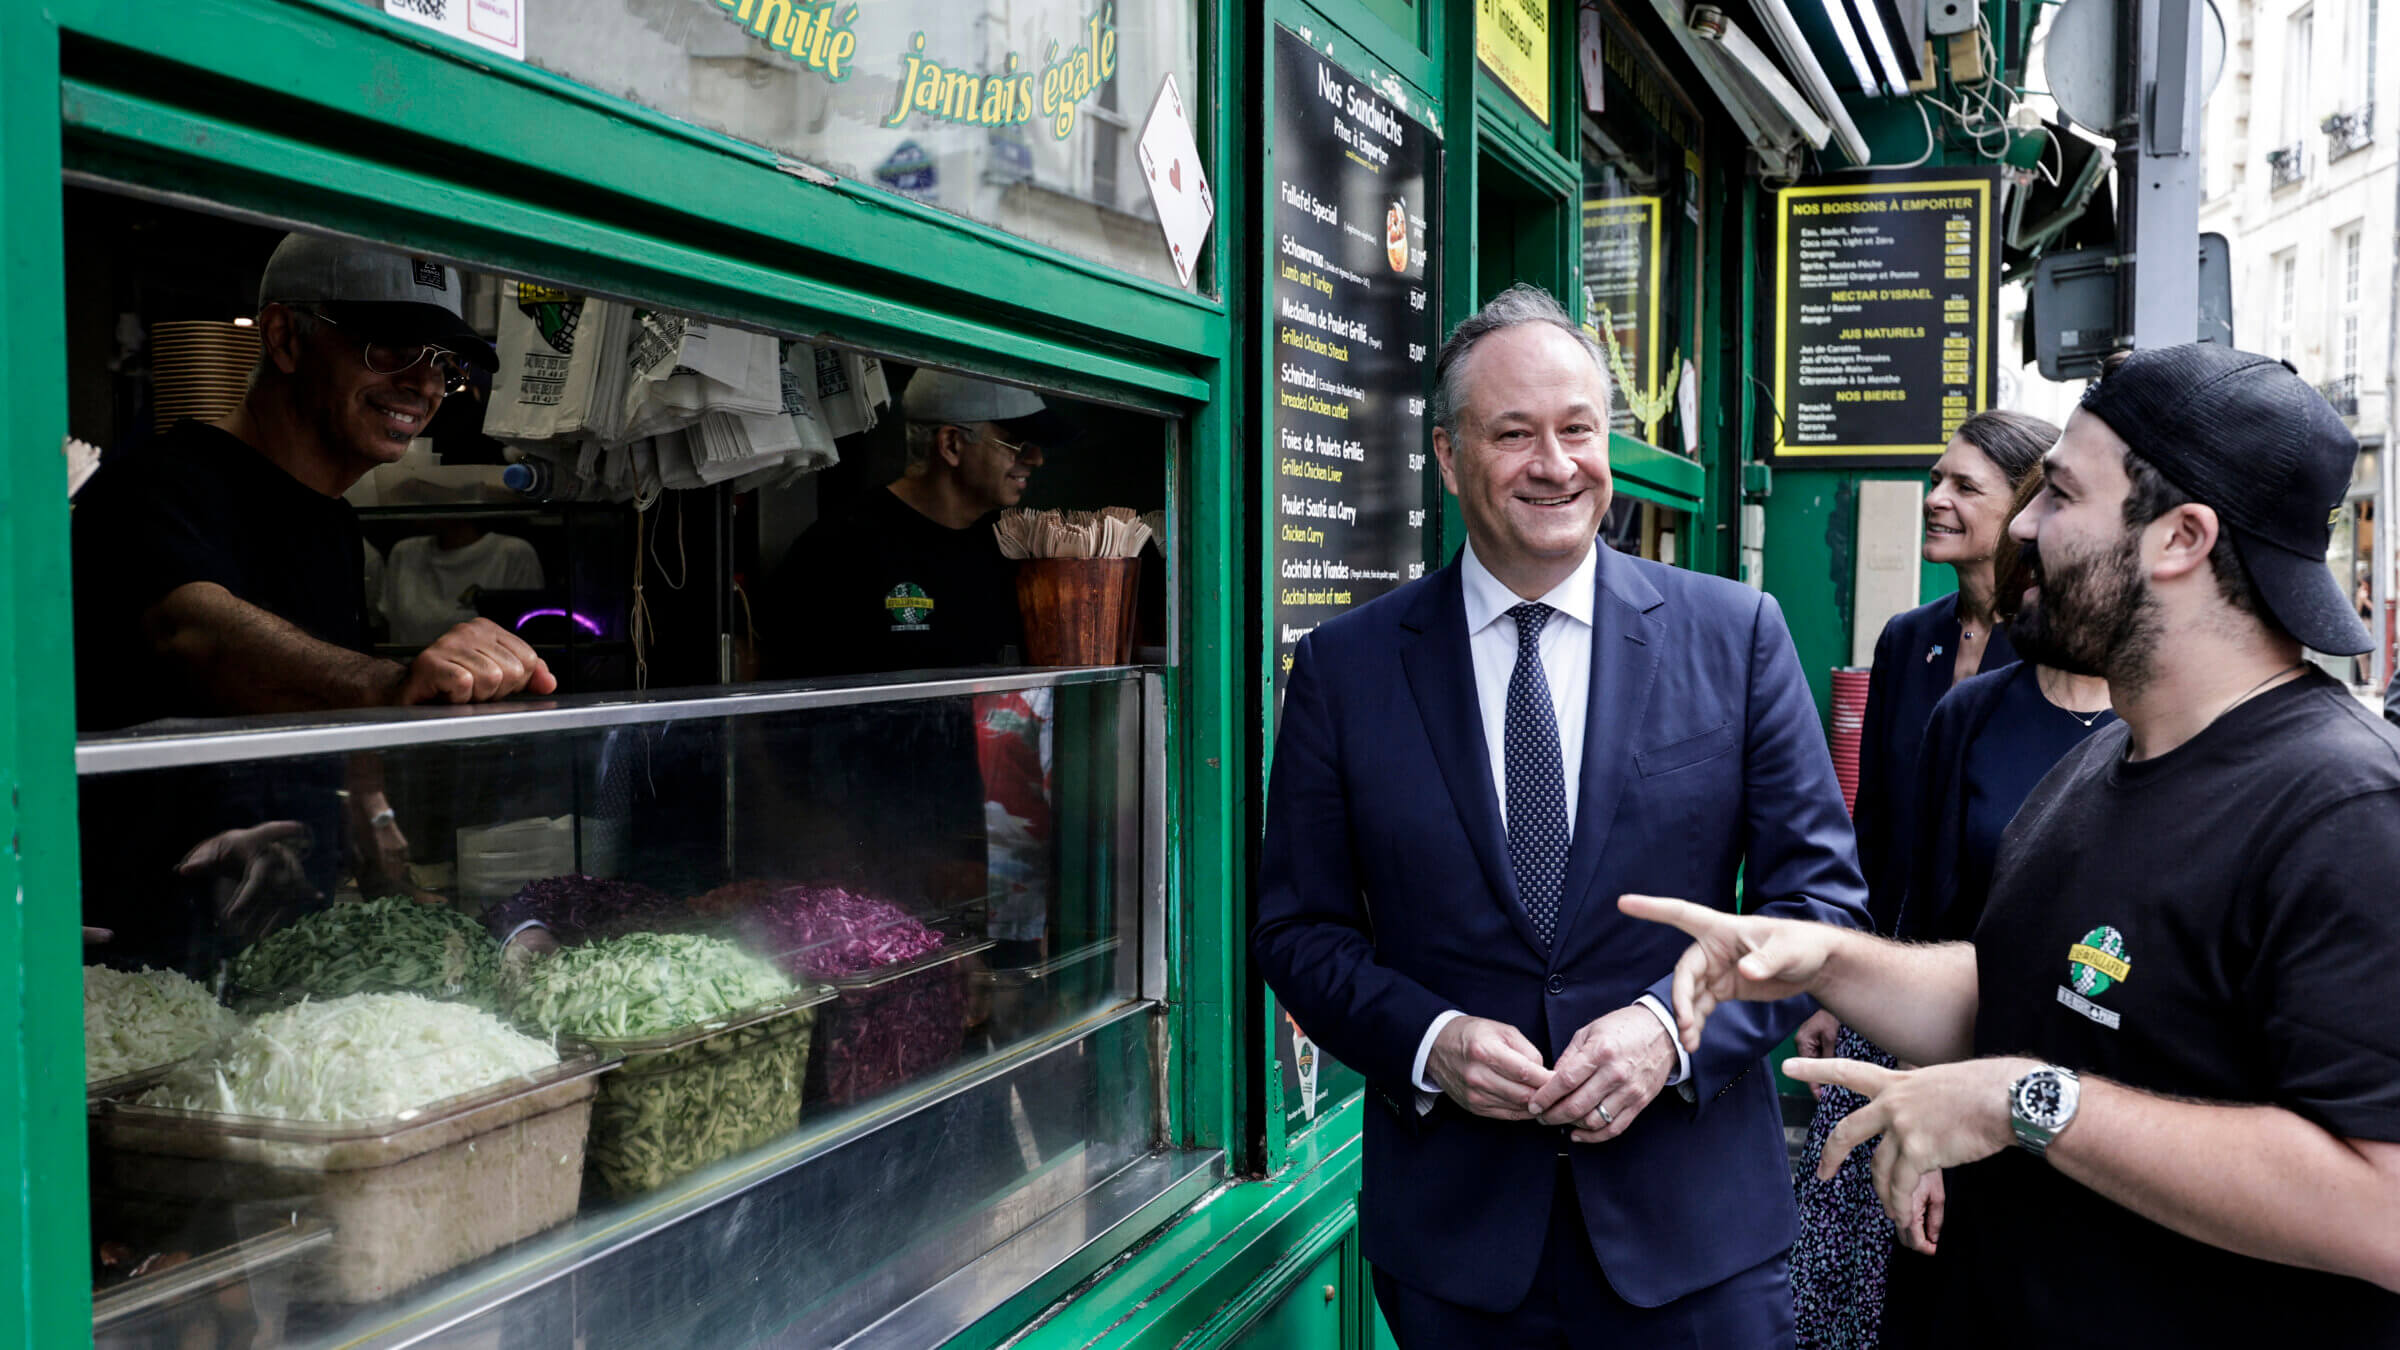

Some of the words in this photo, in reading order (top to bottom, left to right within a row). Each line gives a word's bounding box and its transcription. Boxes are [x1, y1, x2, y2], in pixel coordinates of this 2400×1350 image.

[887, 32, 1034, 126] jamais
[1042, 3, 1117, 140] égalé
[1318, 62, 1342, 108] Nos
[1346, 85, 1402, 146] Sandwichs
[1334, 116, 1351, 143] Pitas
[1353, 128, 1358, 147] à
[1359, 132, 1389, 165] Emporter
[1282, 181, 1310, 212] Fallafel
[1312, 197, 1337, 225] Special
[1793, 201, 1820, 216] NOS
[1822, 199, 1888, 214] BOISSONS
[1890, 197, 1900, 212] À
[1902, 196, 1974, 211] EMPORTER
[1842, 237, 1863, 247] Light
[1850, 226, 1879, 235] Perrier
[1282, 234, 1323, 268] Schawarma
[1282, 260, 1298, 282] Lamb
[1300, 268, 1311, 286] and
[1313, 269, 1333, 299] Turkey
[1849, 272, 1878, 282] Orange
[1879, 272, 1888, 280] et
[1831, 291, 1878, 302] NECTAR
[1880, 289, 1933, 300] D'ISRAEL
[1282, 297, 1317, 328] Medaillon
[1318, 313, 1327, 331] de
[1328, 312, 1349, 337] Poulet
[1349, 320, 1367, 344] Grillé
[1282, 326, 1303, 348] Grilled
[1304, 332, 1327, 355] Chicken
[1839, 329, 1862, 340] JUS
[1863, 327, 1925, 338] NATURELS
[1815, 345, 1826, 354] de
[1827, 344, 1861, 354] Carottes
[1282, 362, 1316, 390] Schnitzel
[1799, 376, 1848, 385] Citronnade
[1856, 375, 1866, 384] la
[1867, 374, 1900, 384] Menthe
[1282, 389, 1307, 411] breaded
[1308, 395, 1330, 416] Chicken
[1332, 402, 1348, 420] cutlet
[1836, 391, 1861, 402] NOS
[1863, 390, 1906, 401] BIERES
[1282, 428, 1302, 451] Foies
[1304, 432, 1313, 453] de
[1316, 435, 1341, 458] Poulets
[1343, 440, 1364, 462] Grillés
[1282, 458, 1303, 478] Grilled
[1304, 462, 1327, 480] Chicken
[1328, 466, 1343, 483] Liver
[1282, 494, 1305, 516] Poulet
[1306, 498, 1326, 517] Sauté
[1328, 504, 1337, 518] au
[1338, 501, 1356, 527] Curry
[1282, 524, 1306, 542] Chicken
[1307, 526, 1324, 548] Curry
[1282, 558, 1311, 579] Cocktail
[1313, 560, 1322, 579] de
[1323, 560, 1349, 580] Viandes
[1282, 588, 1306, 605] Cocktail
[1308, 588, 1325, 605] mixed
[1326, 587, 1333, 606] of
[1334, 590, 1352, 605] meats
